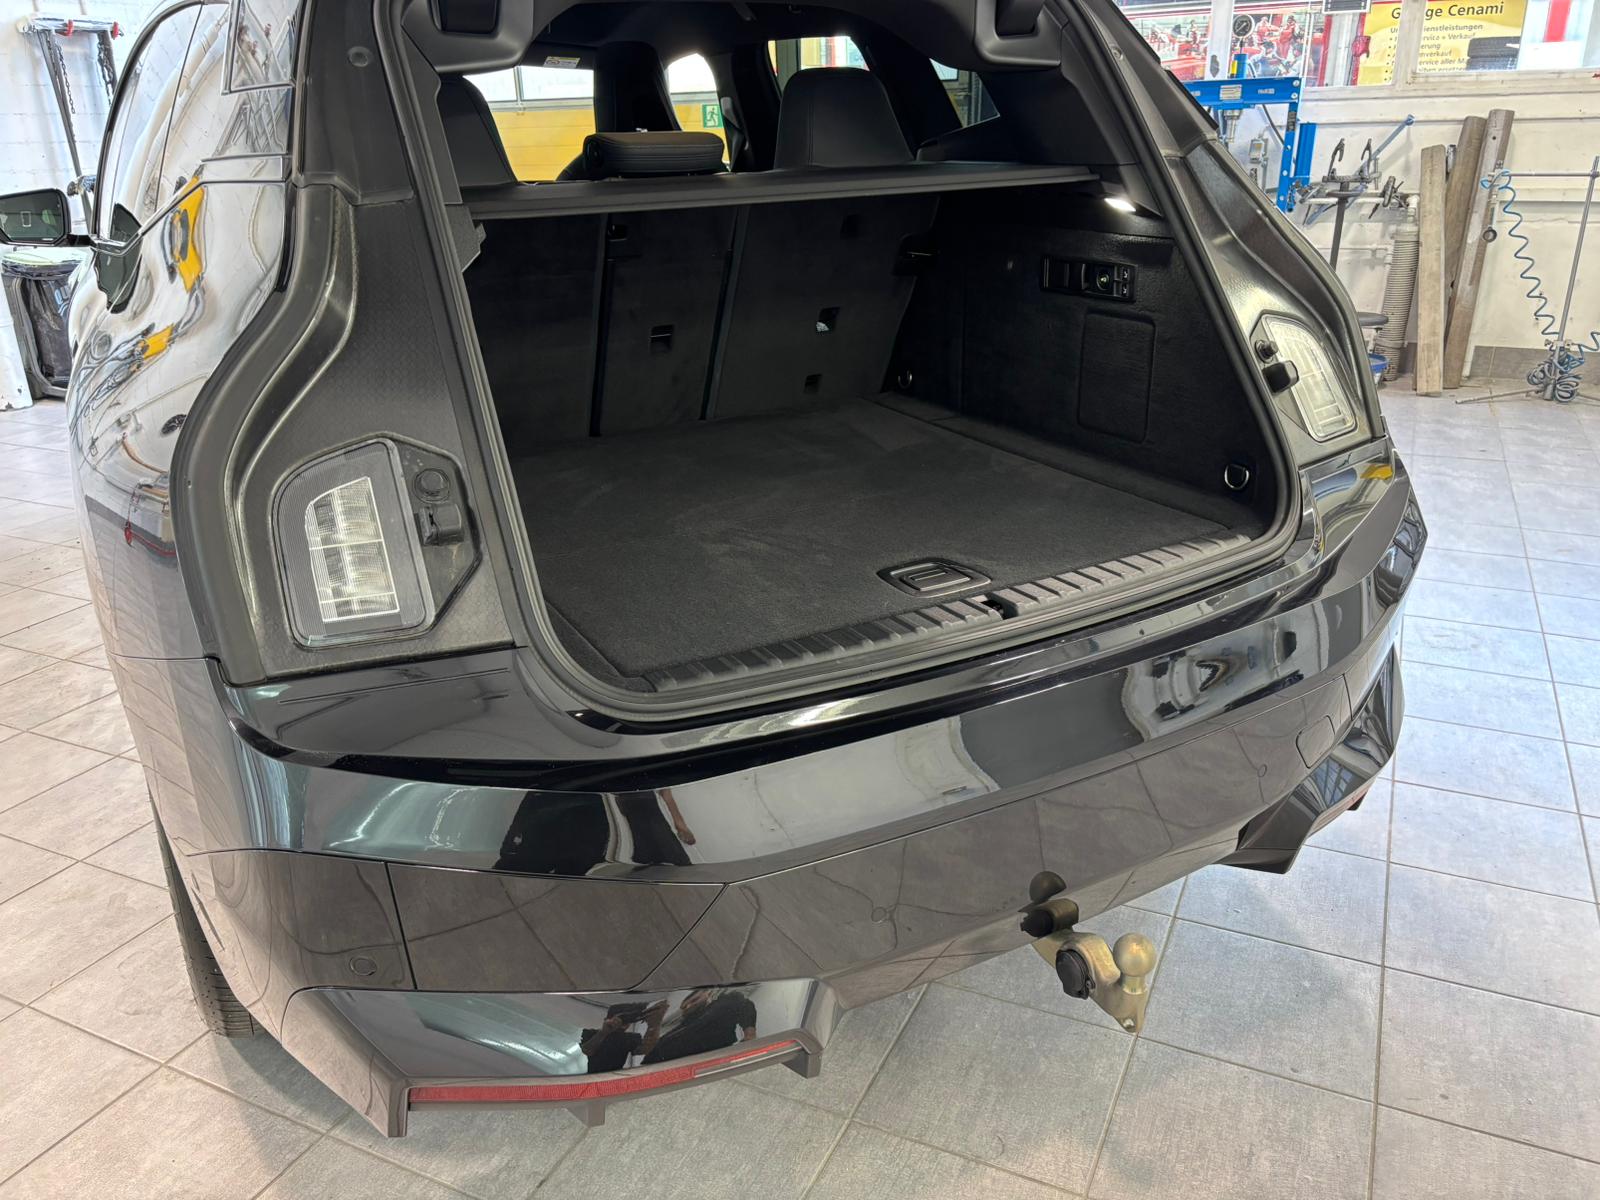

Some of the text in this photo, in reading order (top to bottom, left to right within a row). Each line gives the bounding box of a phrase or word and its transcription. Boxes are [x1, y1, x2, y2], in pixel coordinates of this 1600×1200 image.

[1391, 2, 1504, 20] Gge Cenami
[1423, 24, 1484, 32] ienstleistungen
